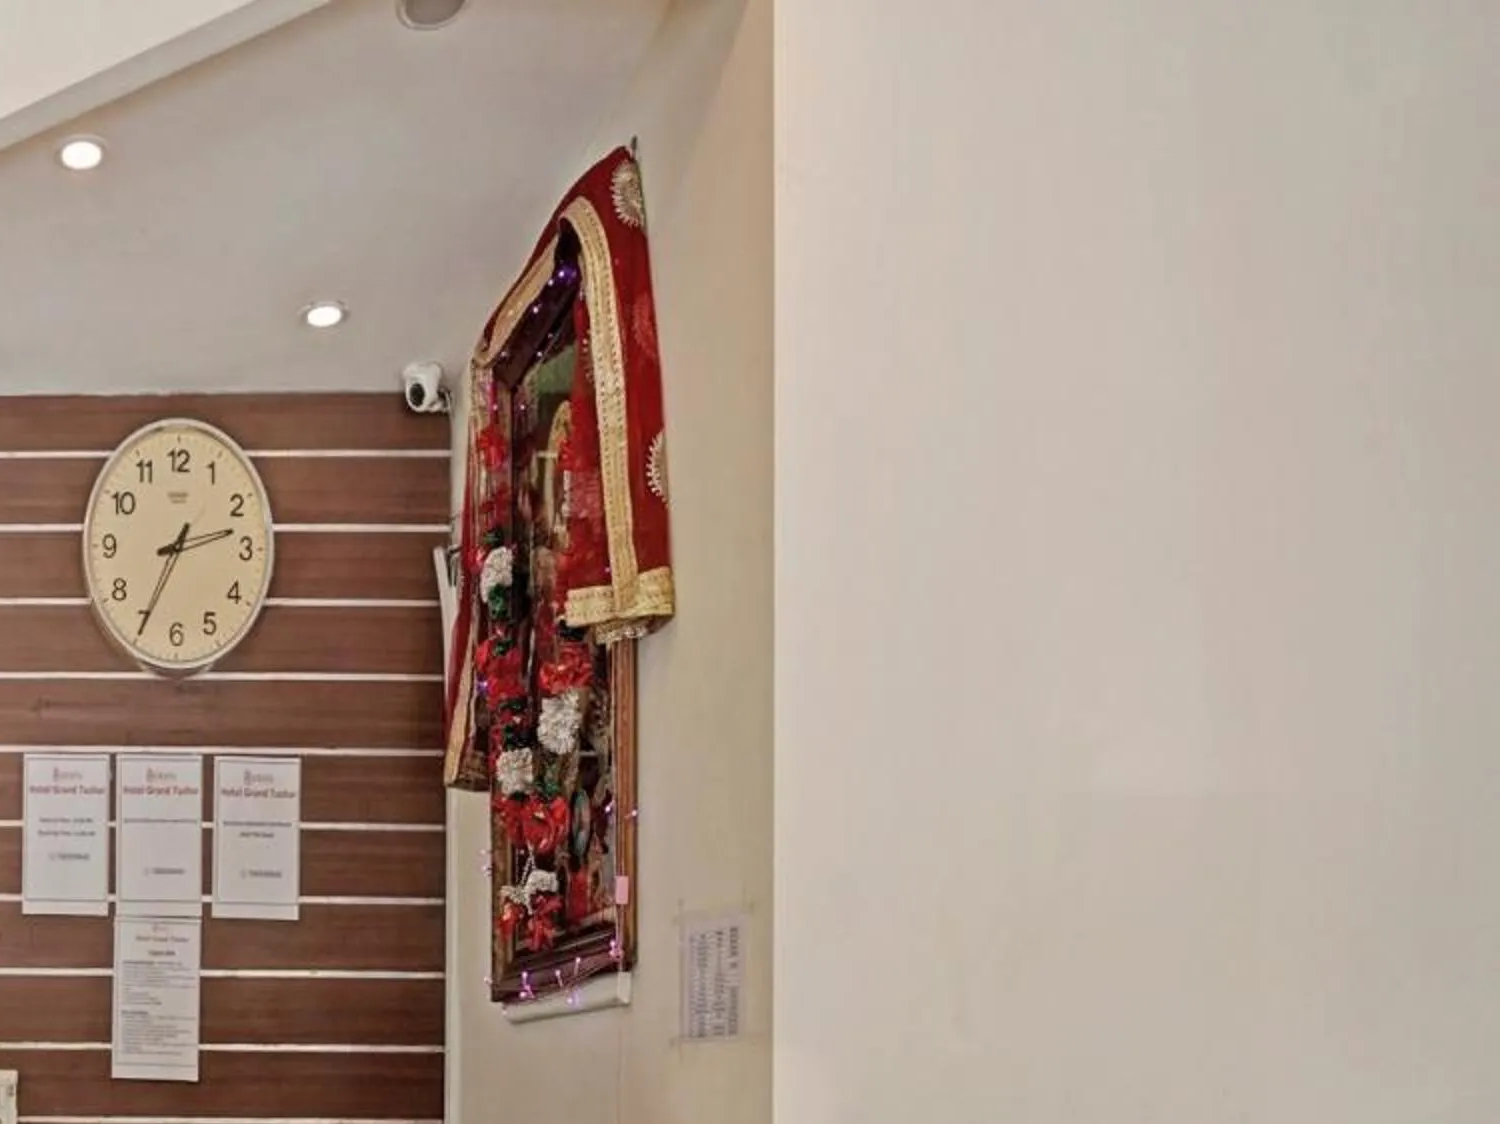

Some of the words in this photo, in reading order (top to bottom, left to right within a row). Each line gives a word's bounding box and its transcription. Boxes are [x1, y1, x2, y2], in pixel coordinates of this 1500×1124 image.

[136, 460, 153, 484] 11
[167, 449, 190, 473] 12
[206, 462, 216, 485] 1
[112, 491, 136, 515] 10
[230, 493, 244, 517] 2
[102, 534, 117, 559] 9
[239, 536, 253, 561] 3
[112, 578, 127, 601] 8
[227, 581, 242, 604] 4
[138, 610, 150, 636] 7
[169, 622, 184, 647] 6
[203, 612, 217, 635] 5
